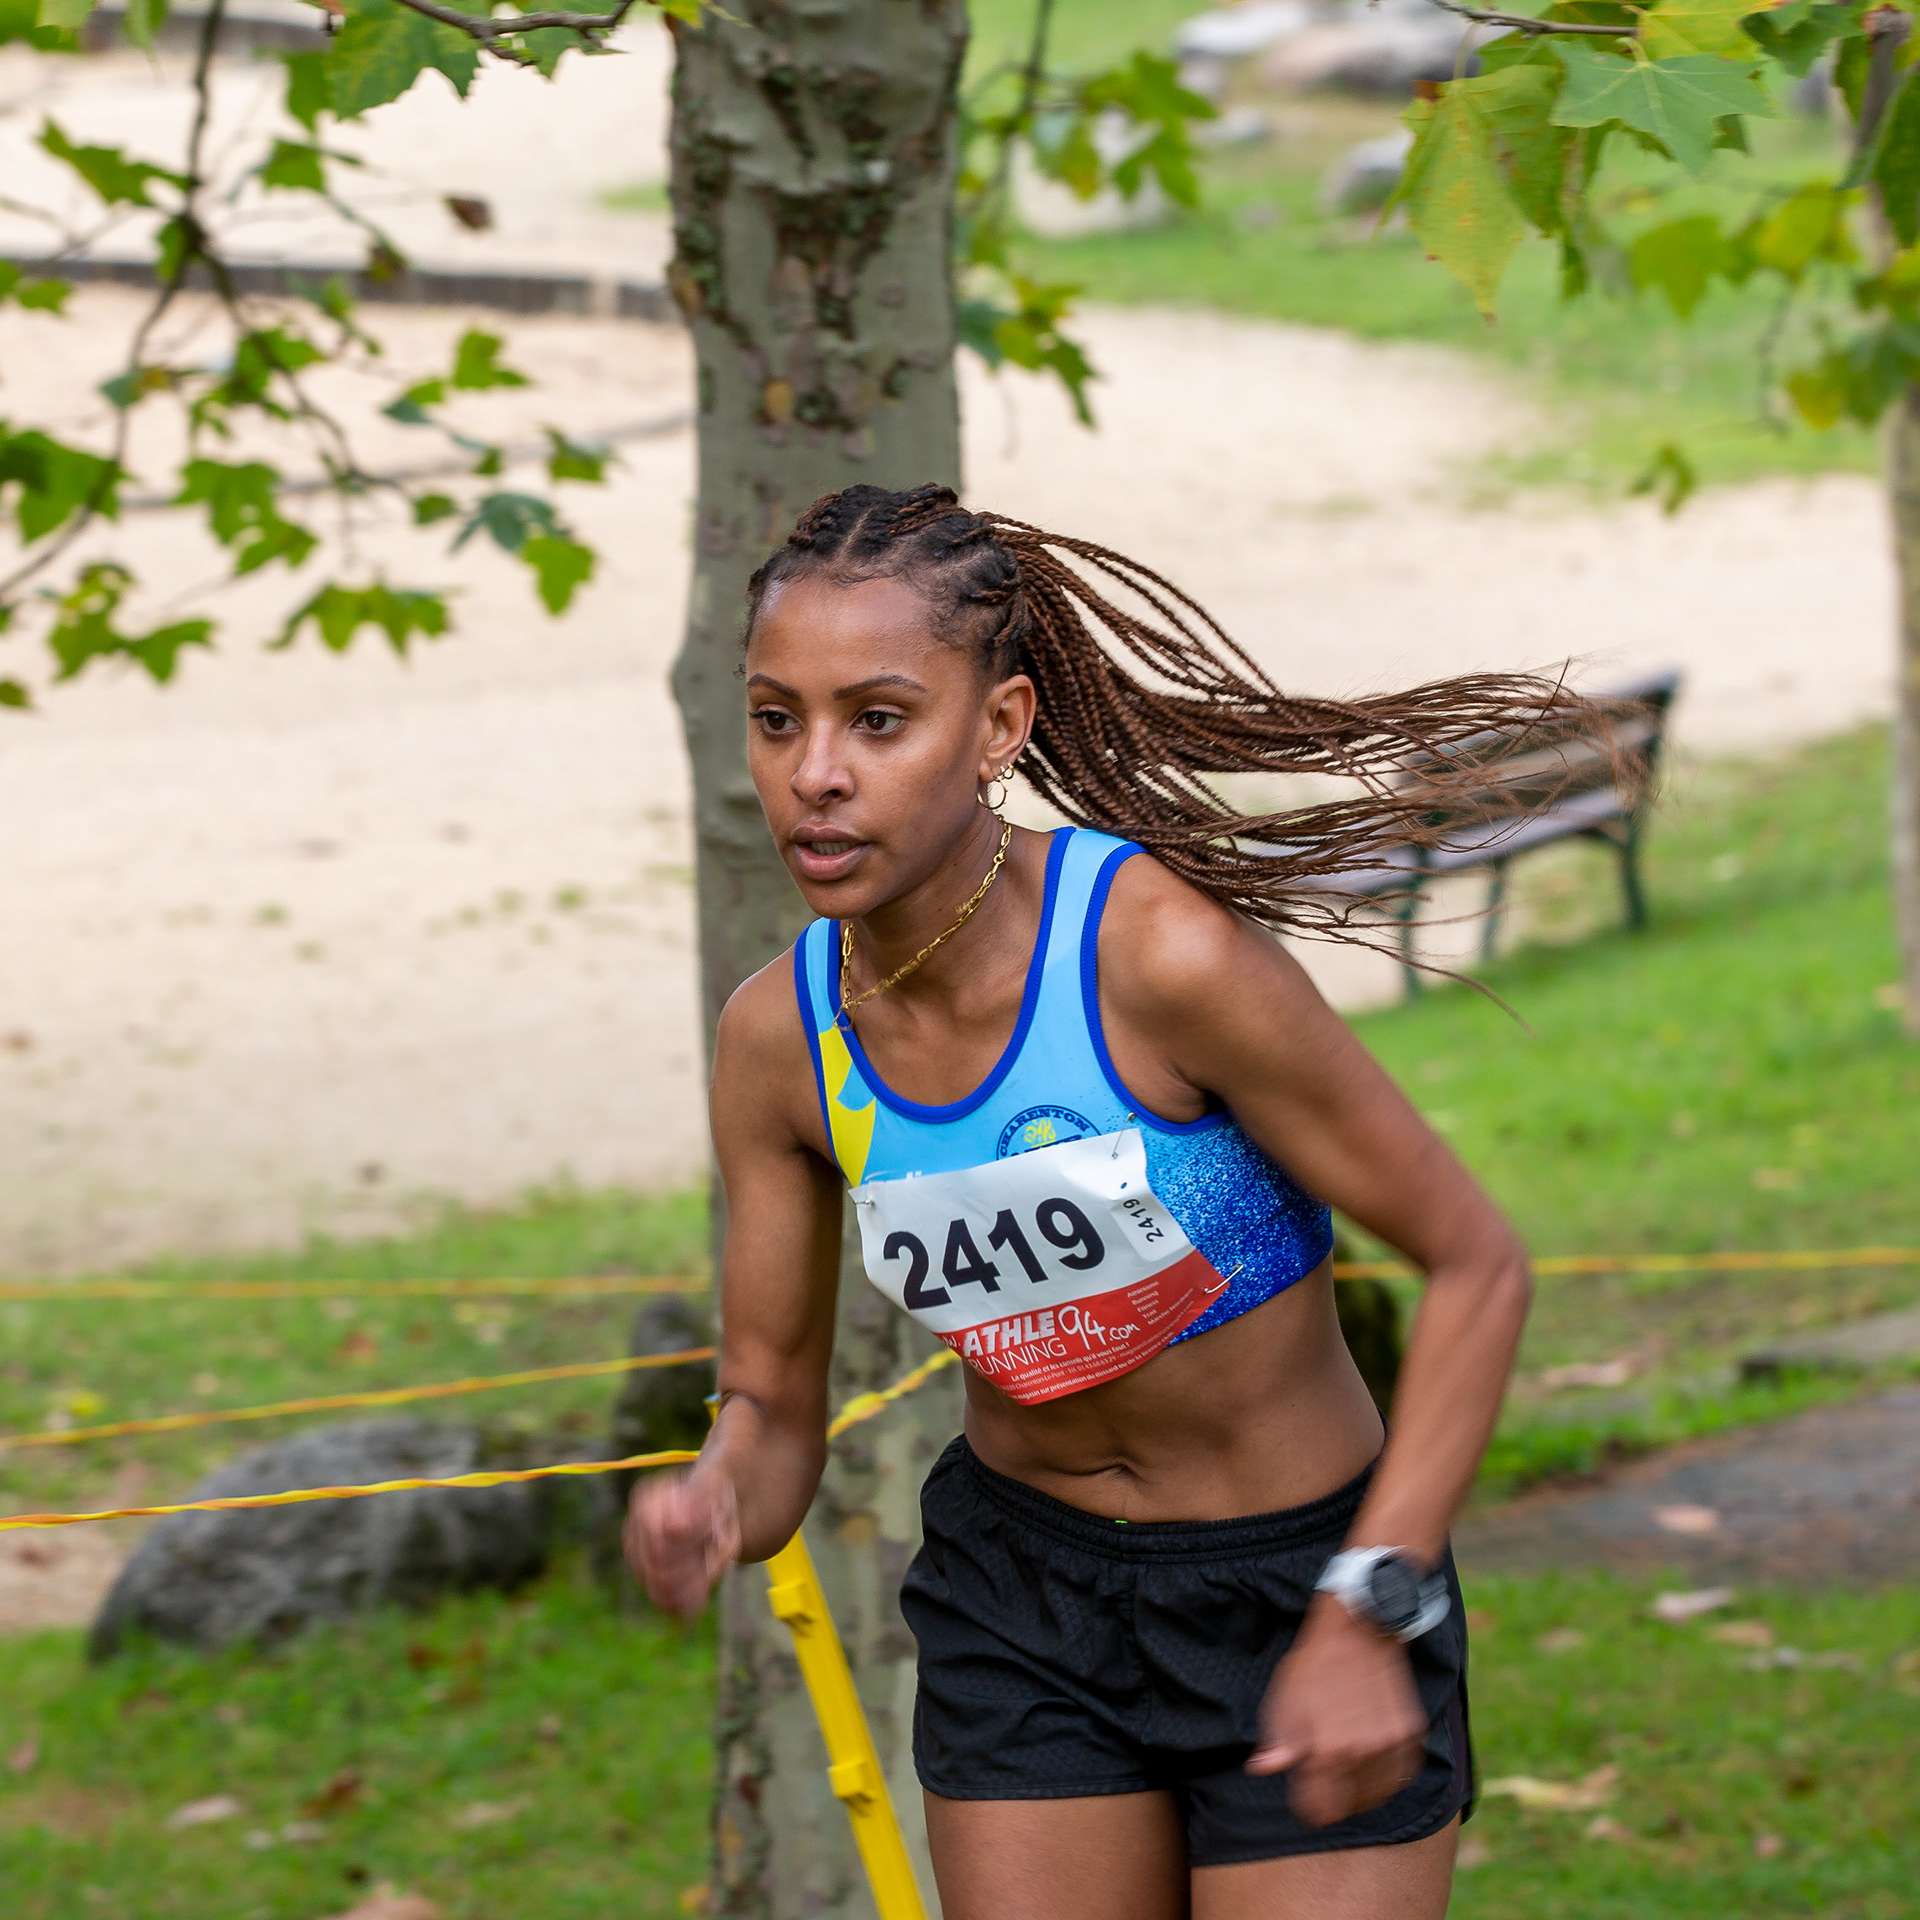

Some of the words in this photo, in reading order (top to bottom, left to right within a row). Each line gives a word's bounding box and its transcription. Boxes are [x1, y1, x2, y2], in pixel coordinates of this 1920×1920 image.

[1001, 1108, 1090, 1157] CHARENTON
[1123, 1199, 1164, 1242] 2419
[883, 1197, 1106, 1310] 2419
[963, 1310, 1055, 1357] ATHLE
